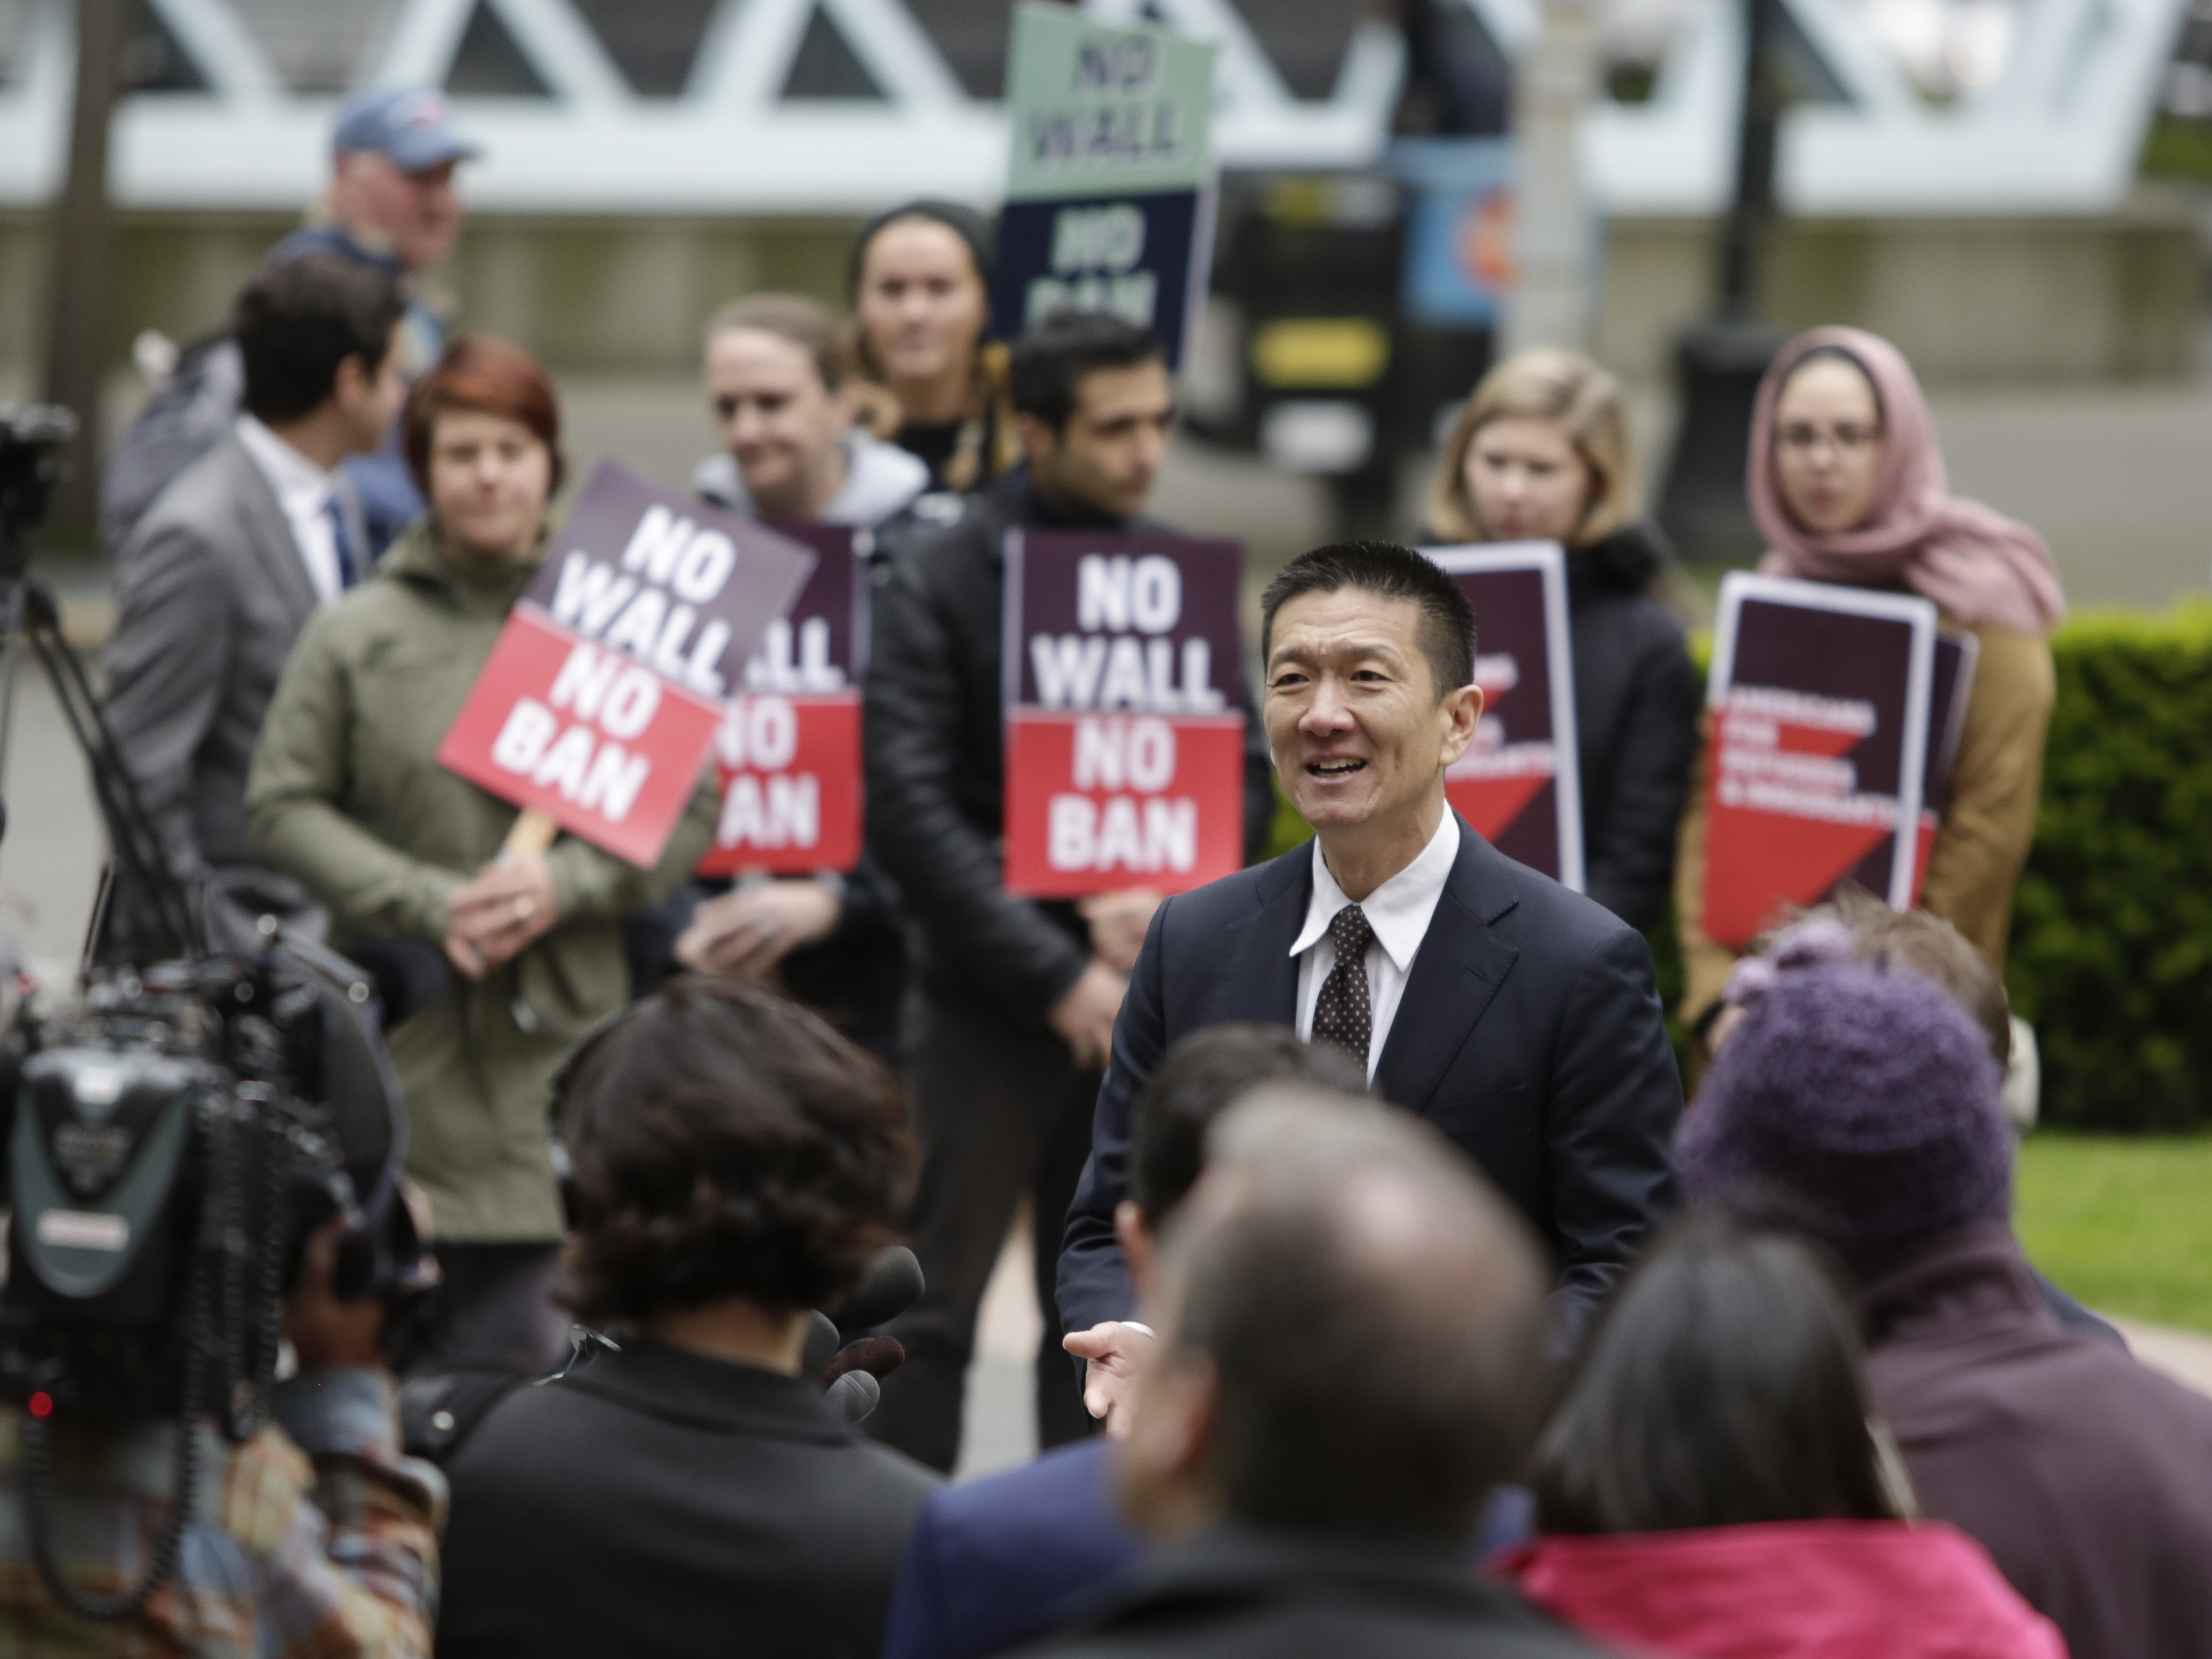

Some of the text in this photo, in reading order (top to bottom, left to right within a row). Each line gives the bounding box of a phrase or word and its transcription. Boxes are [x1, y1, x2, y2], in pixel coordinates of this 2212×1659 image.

[1077, 37, 1163, 94] NO
[1028, 99, 1182, 166] WALL
[1051, 205, 1146, 274] NO
[622, 505, 735, 603] NO
[1078, 554, 1182, 634] NO
[552, 549, 729, 697] WALL
[745, 618, 846, 692] LL
[548, 641, 662, 740] NO
[1029, 633, 1229, 715] WALL
[491, 698, 651, 823] BAN
[1073, 716, 1176, 793] NO
[717, 773, 819, 849] AN
[1048, 793, 1197, 873] BAN
